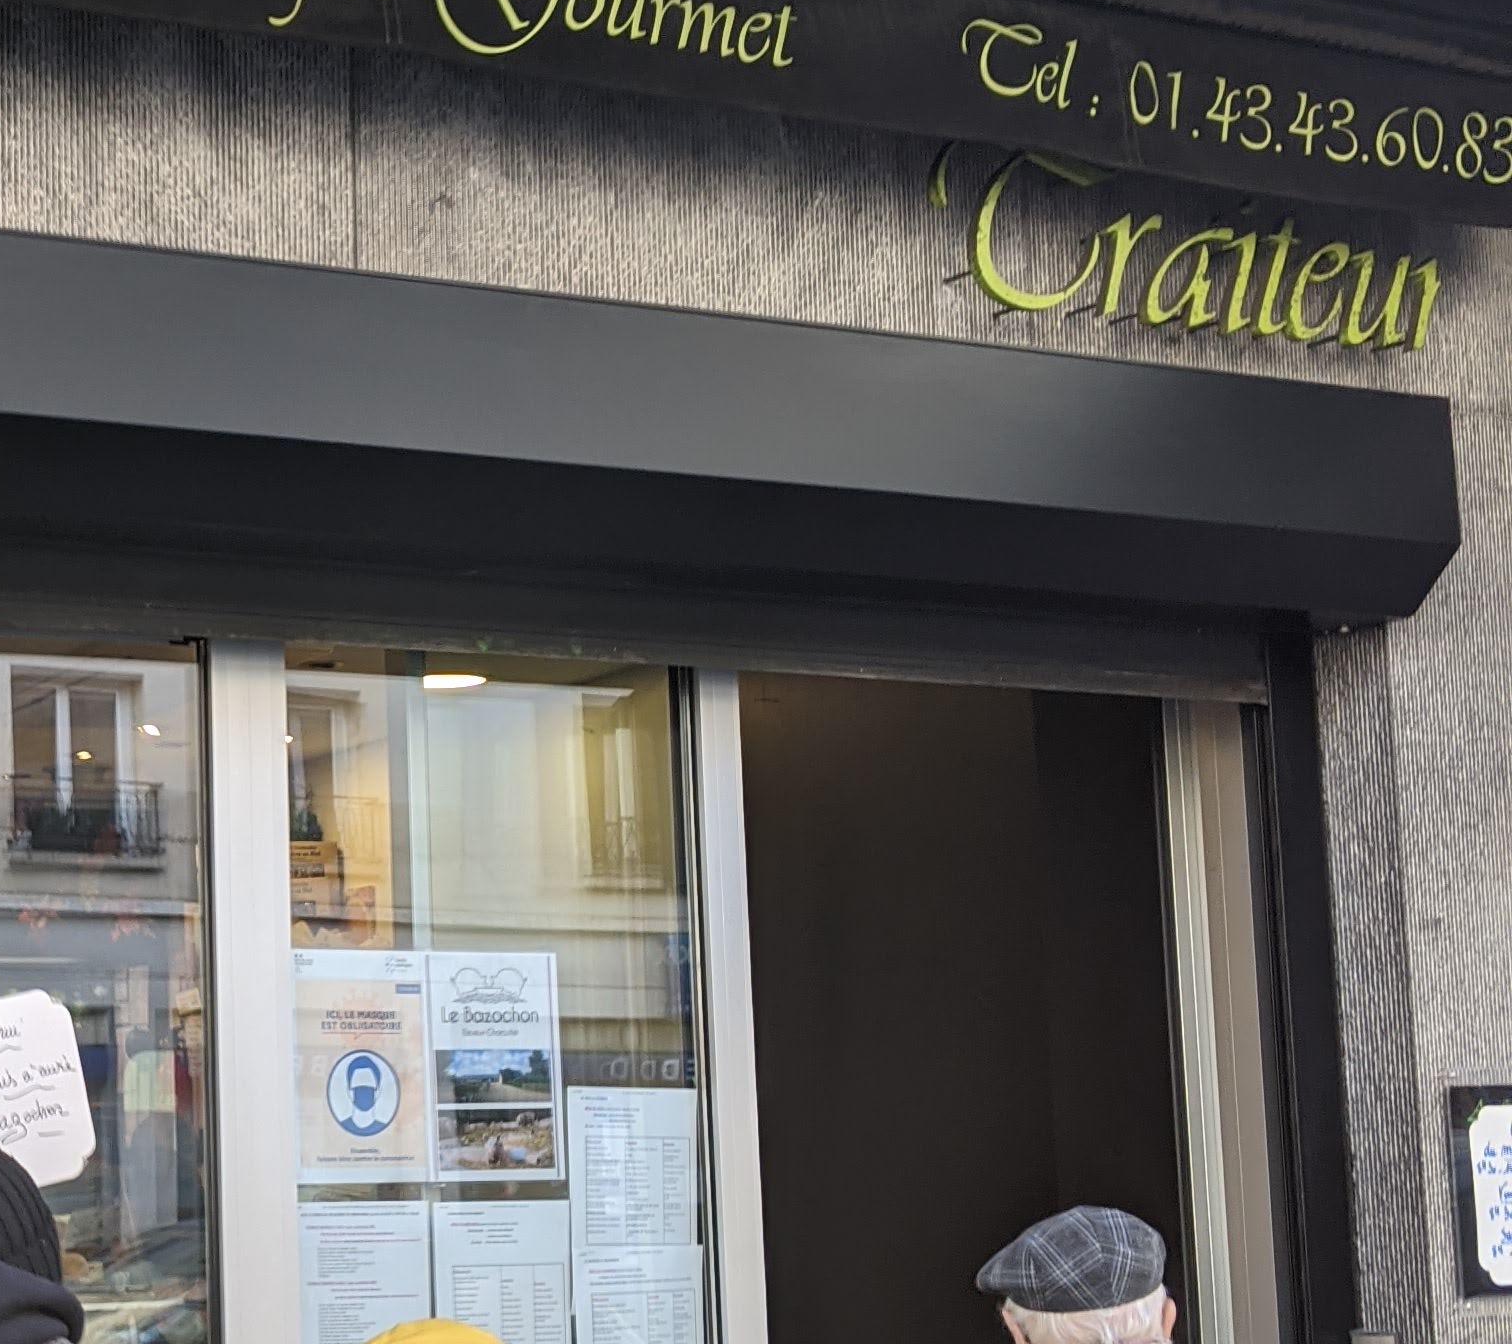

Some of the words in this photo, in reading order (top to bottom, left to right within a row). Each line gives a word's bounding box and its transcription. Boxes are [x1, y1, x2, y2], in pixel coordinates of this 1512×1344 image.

[1129, 60, 1512, 184] 01.43.43.60.83
[441, 1006, 459, 1023] Le
[463, 1005, 540, 1024] Bazochon
